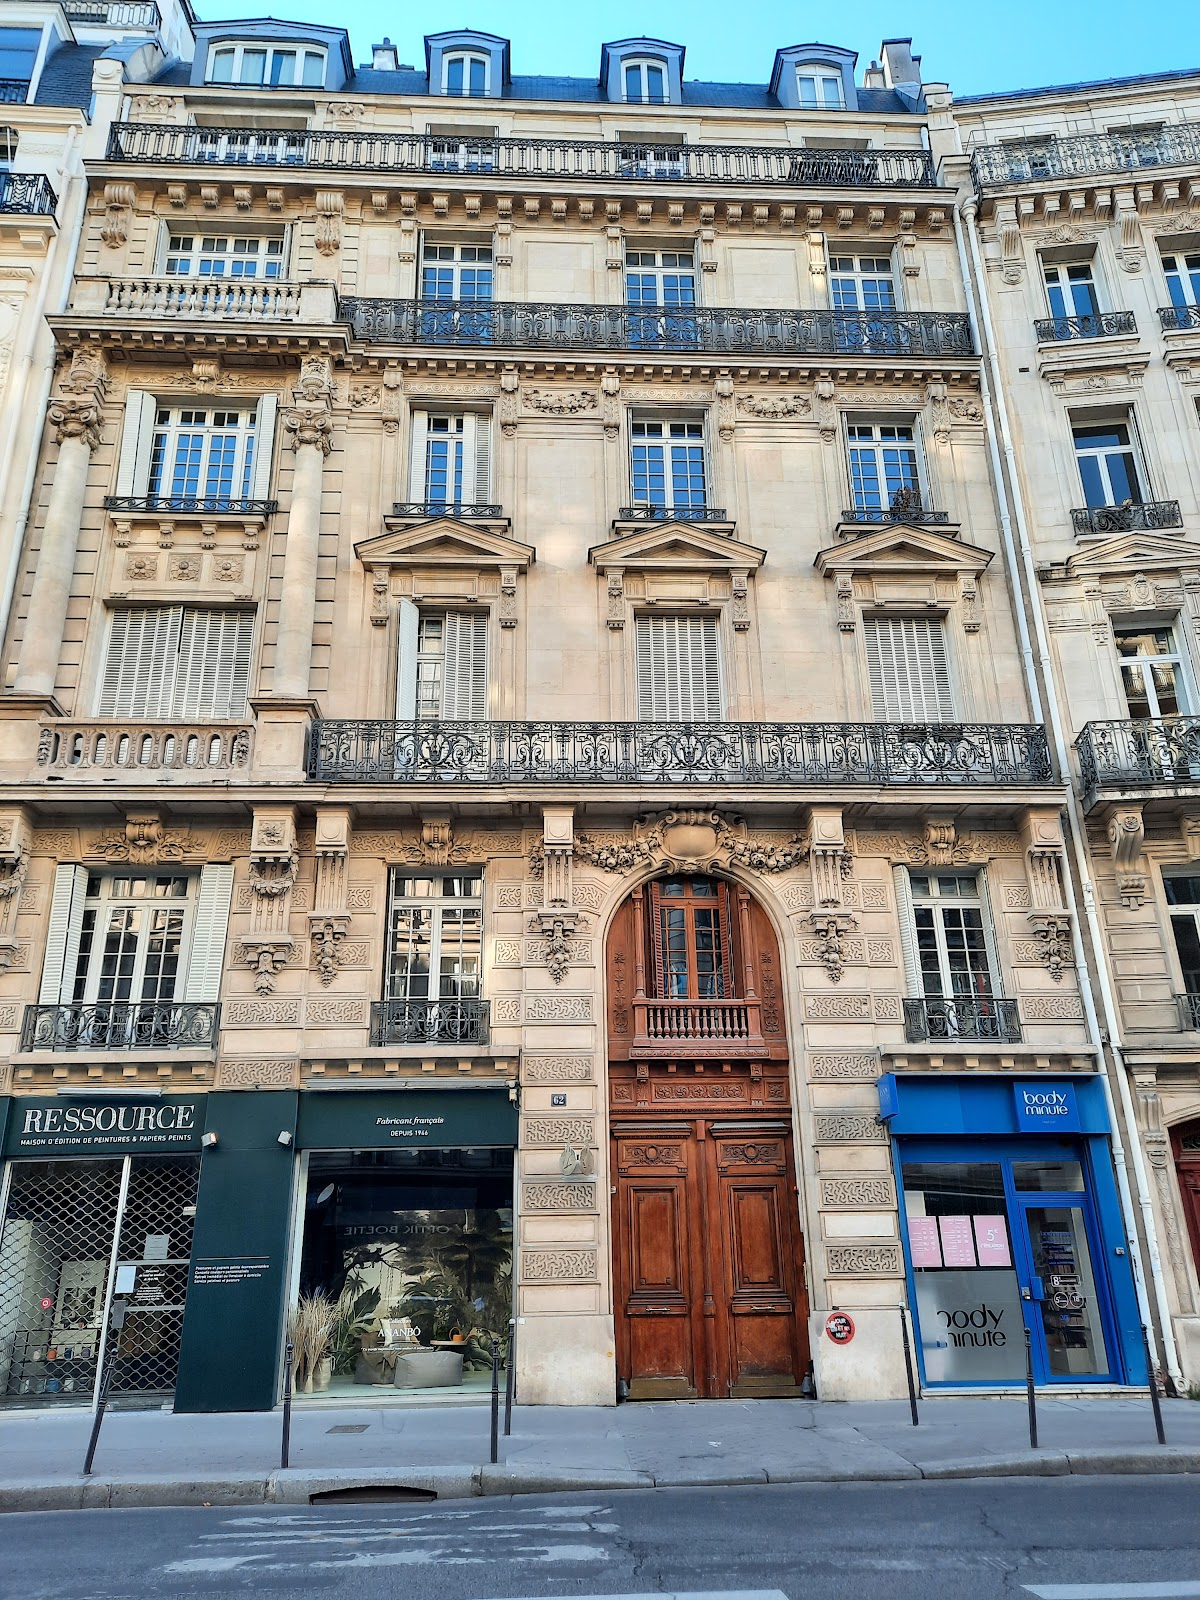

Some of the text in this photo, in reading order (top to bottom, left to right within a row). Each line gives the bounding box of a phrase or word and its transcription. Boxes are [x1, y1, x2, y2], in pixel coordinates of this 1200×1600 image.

[553, 1095, 565, 1105] 62
[1023, 1090, 1067, 1105] body
[1025, 1105, 1069, 1115] minute
[21, 1105, 195, 1134] RESSOURCE
[375, 1116, 445, 1126] Fabricant français
[20, 1133, 192, 1146] MAISON D'ÉDITION DE PEINTURES & PAPIERS PEINTS
[377, 1325, 421, 1338] ANANBÔ
